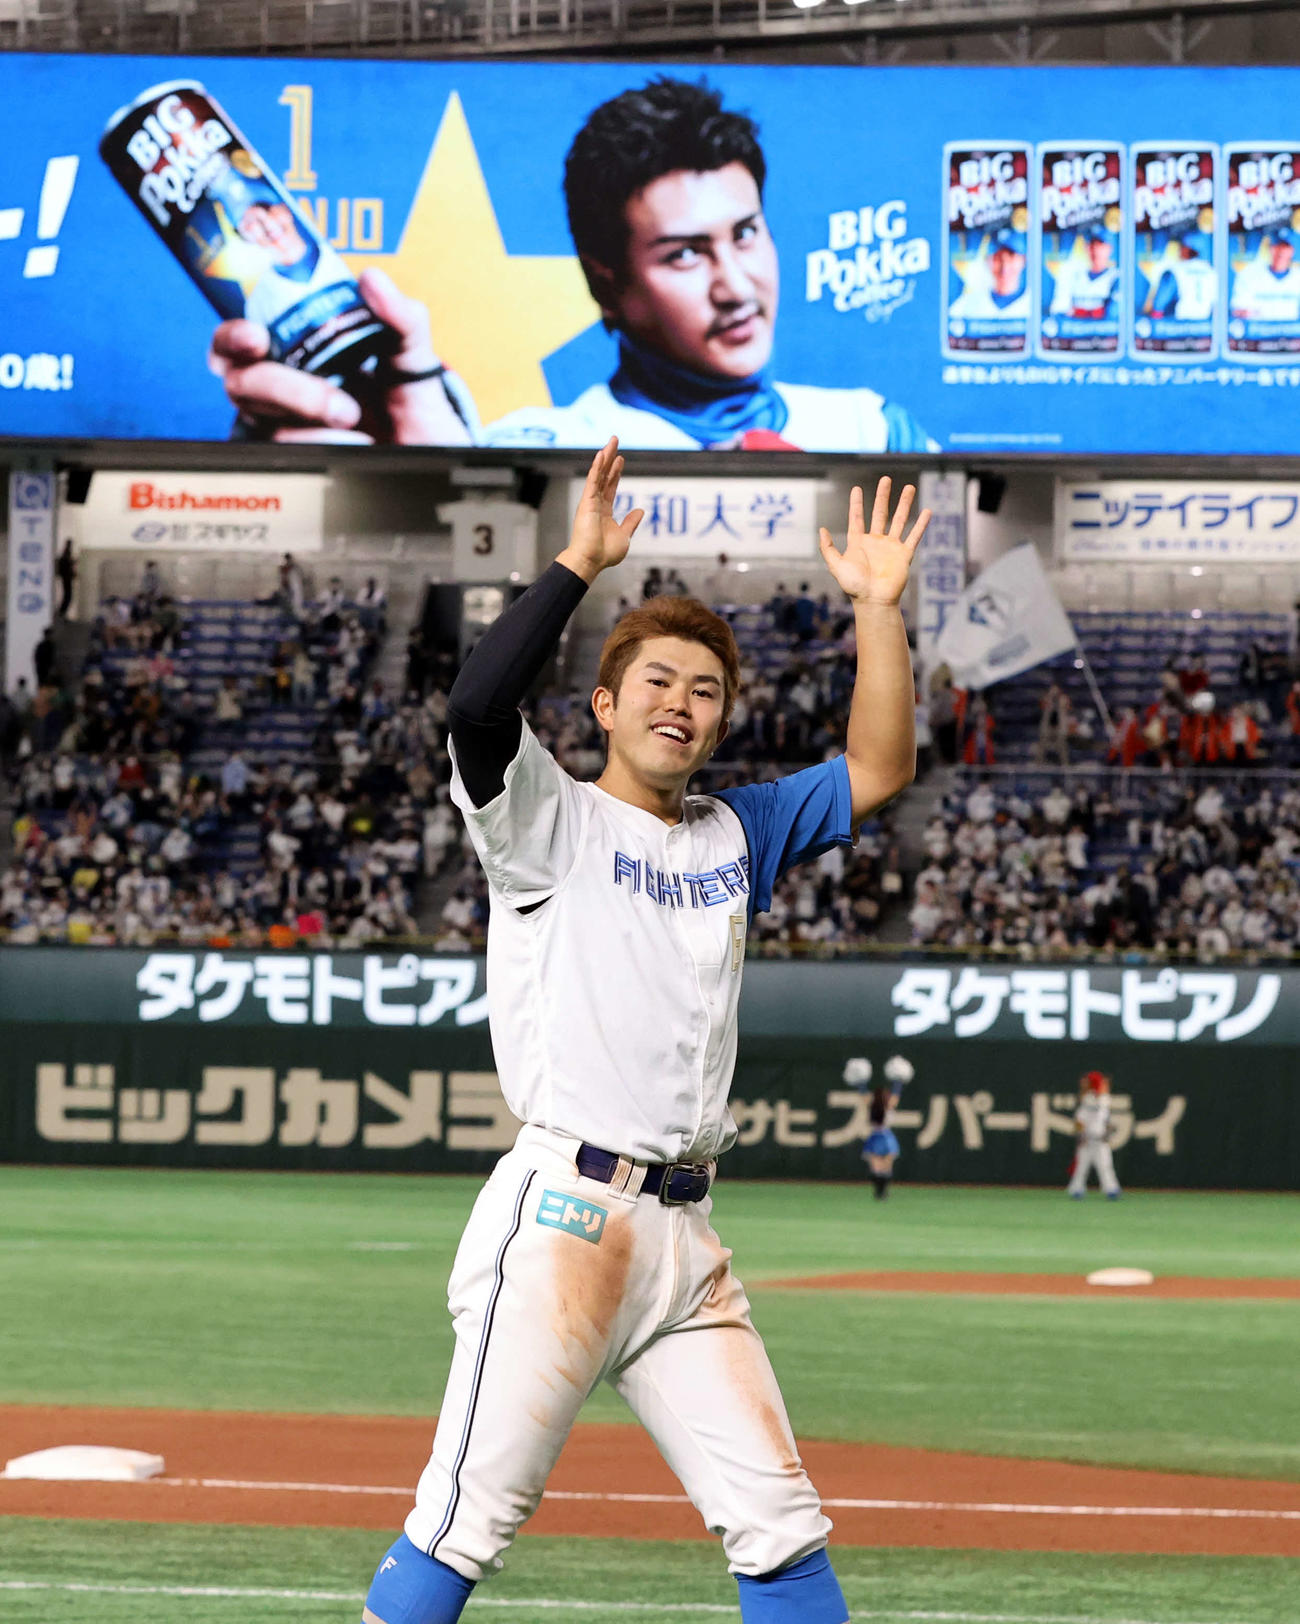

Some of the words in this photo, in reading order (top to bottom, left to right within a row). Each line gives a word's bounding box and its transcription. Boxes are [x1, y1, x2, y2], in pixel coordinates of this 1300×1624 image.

[127, 94, 196, 173] BIG
[278, 85, 317, 190] 1
[959, 152, 1014, 188] BIG
[1052, 152, 1107, 188] BIG
[1145, 153, 1200, 188] BIG
[1238, 153, 1293, 189] BIG
[829, 200, 907, 251] BIG
[806, 238, 930, 302] Pokka
[129, 482, 282, 511] Bishamon
[1071, 492, 1300, 529] ニッテイライフ
[473, 524, 494, 555] 3
[891, 966, 1282, 1042] タケモトピアノ
[35, 1062, 520, 1150] ビックカメラ
[731, 1090, 1187, 1155] サヒスーパードライ
[541, 1196, 602, 1234] ニトリ
